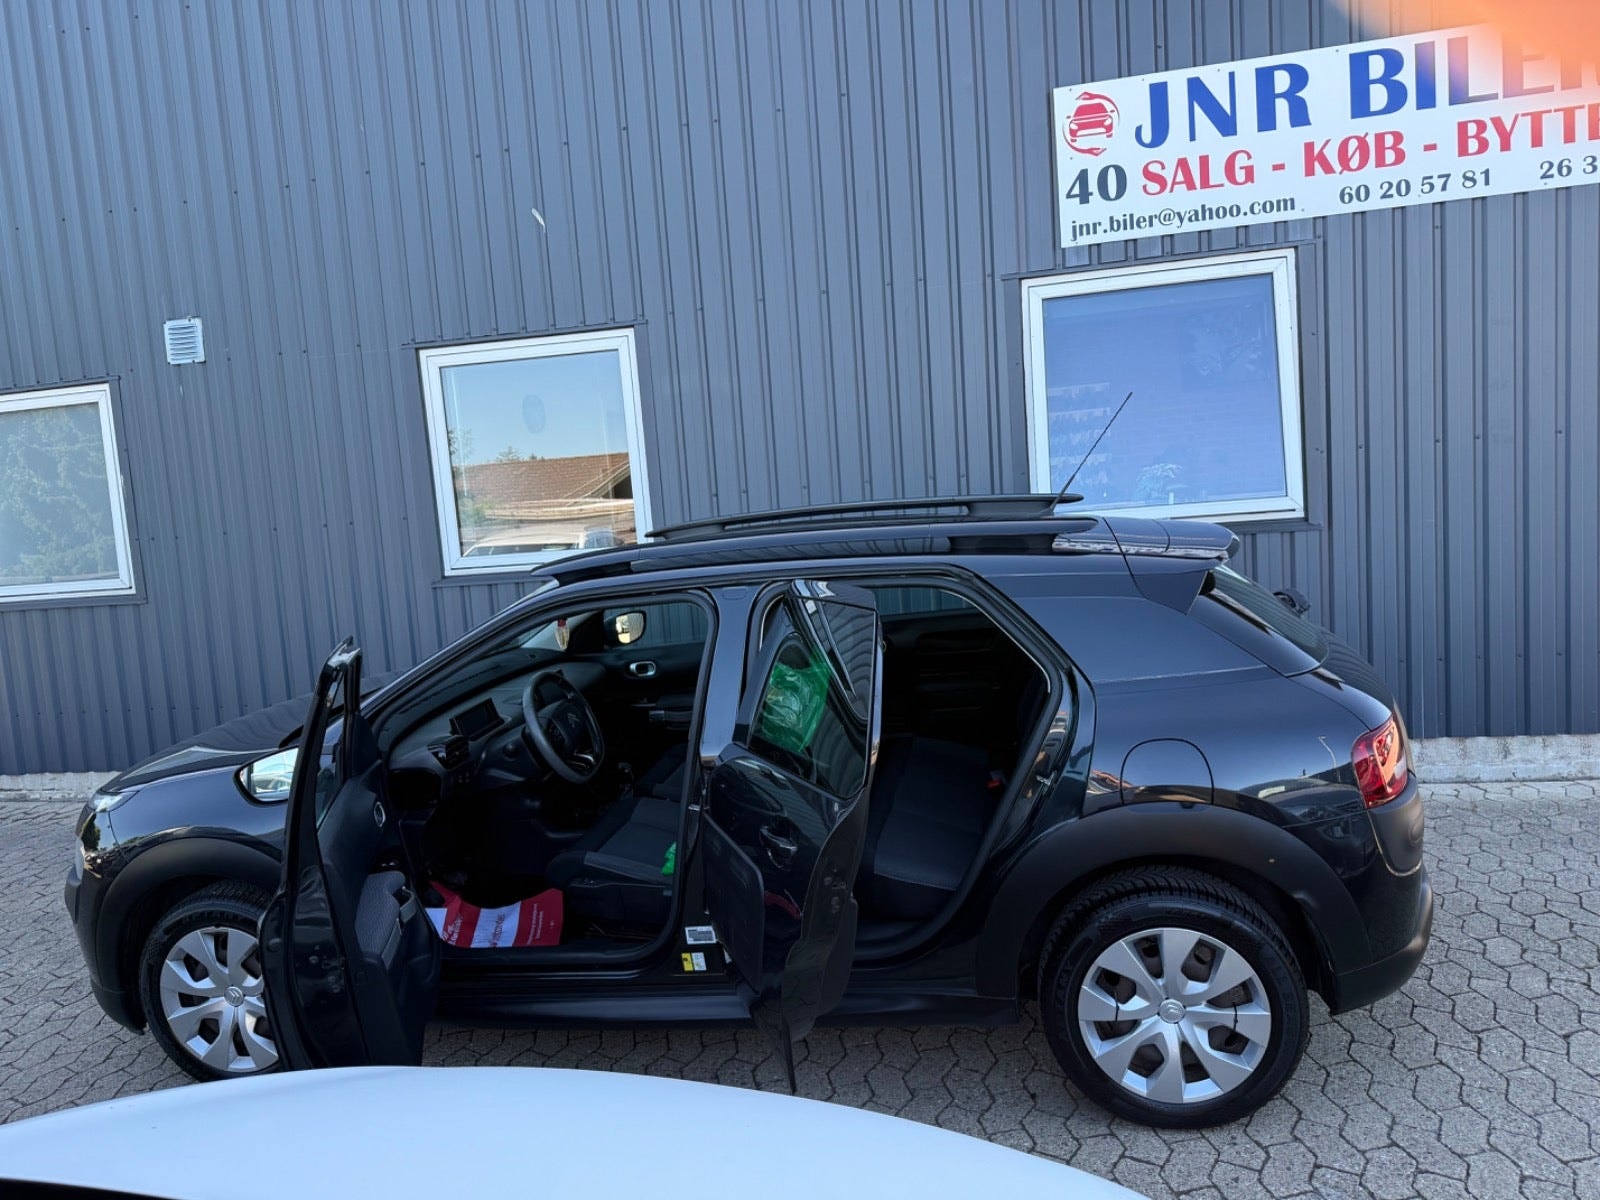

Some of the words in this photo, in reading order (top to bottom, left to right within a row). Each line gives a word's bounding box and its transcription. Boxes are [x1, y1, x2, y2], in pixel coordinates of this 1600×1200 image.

[1135, 62, 1312, 149] JNR
[1142, 149, 1255, 196] SALG
[1303, 130, 1406, 177] KØB
[1539, 157, 1573, 180] 26
[1582, 155, 1598, 174] 3
[1065, 164, 1128, 205] 40
[1339, 184, 1370, 205] 60
[1379, 178, 1411, 199] 20
[1420, 172, 1451, 194] 57
[1461, 167, 1491, 189] 81
[1070, 197, 1296, 241] jnr.biler@yahoo.com
